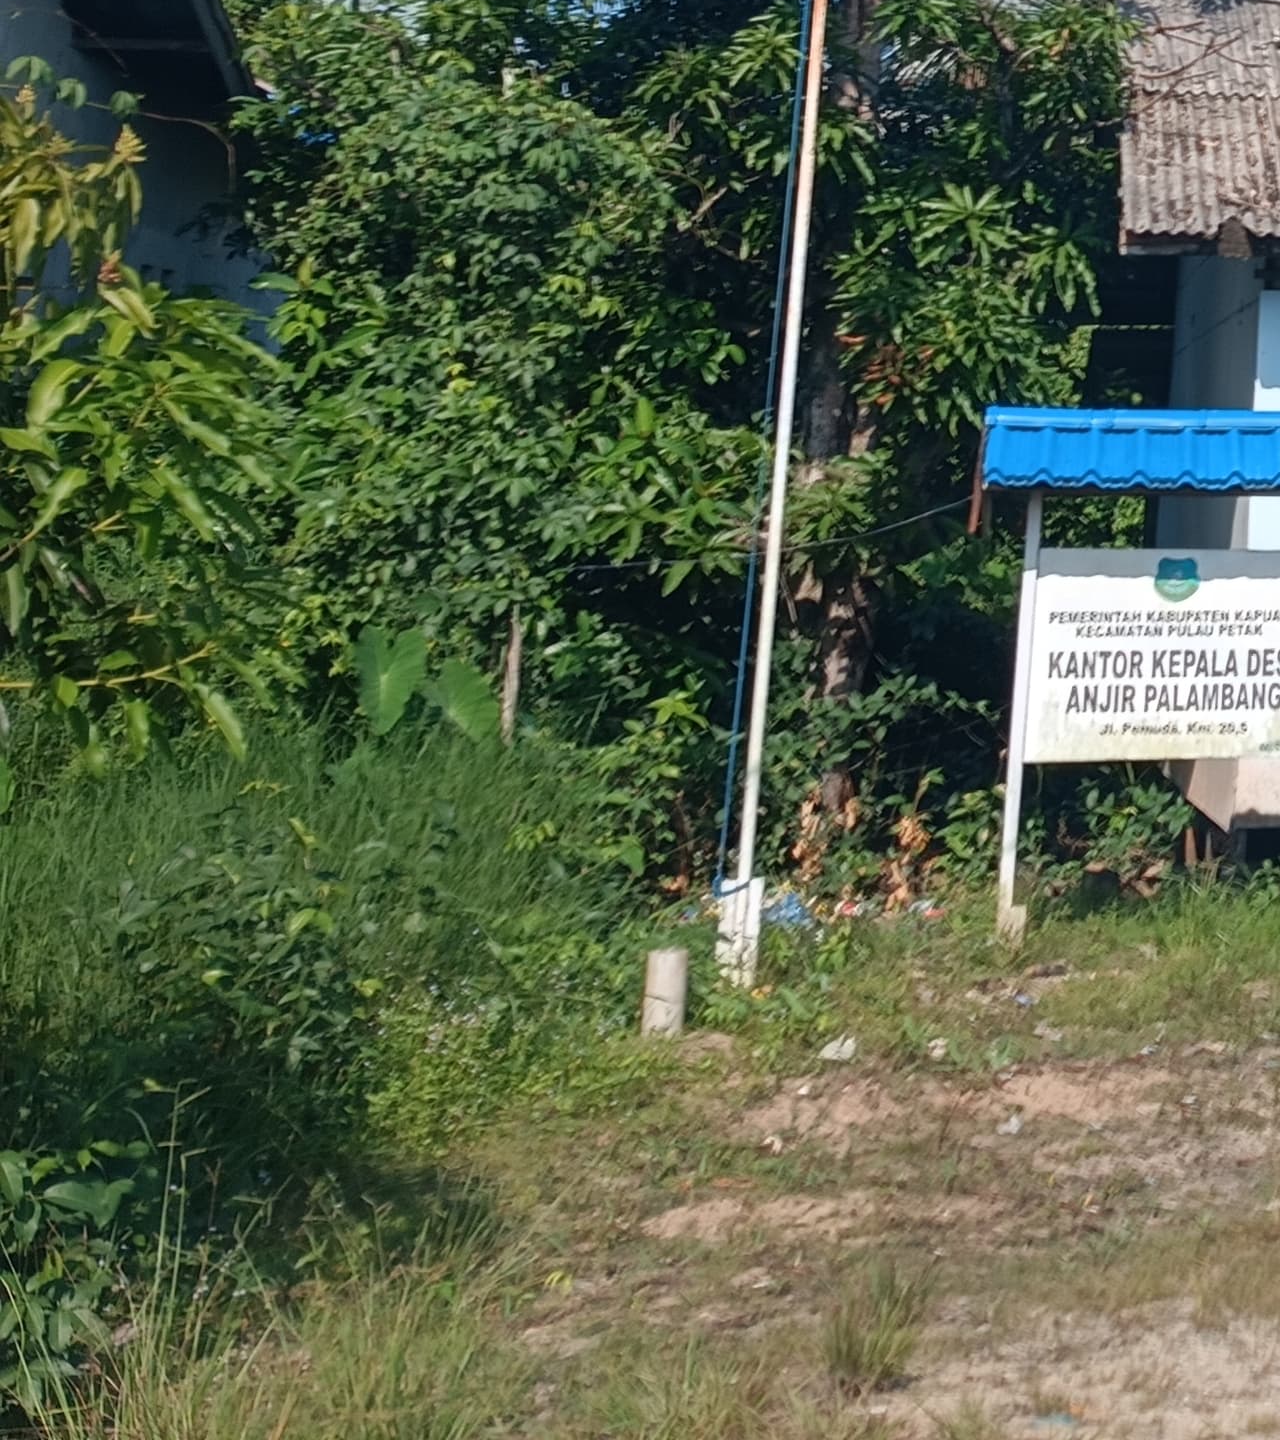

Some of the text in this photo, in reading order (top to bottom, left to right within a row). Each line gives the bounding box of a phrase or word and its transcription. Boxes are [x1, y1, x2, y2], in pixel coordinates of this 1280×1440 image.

[1048, 610, 1142, 625] PEMERINTAH
[1146, 610, 1230, 624] KABUPATEN
[1075, 623, 1264, 638] KECAMATAN PULAU PETAK
[1048, 650, 1144, 679] KANTOR
[1151, 649, 1239, 679] KEPALA
[1064, 684, 1136, 715] ANJIR
